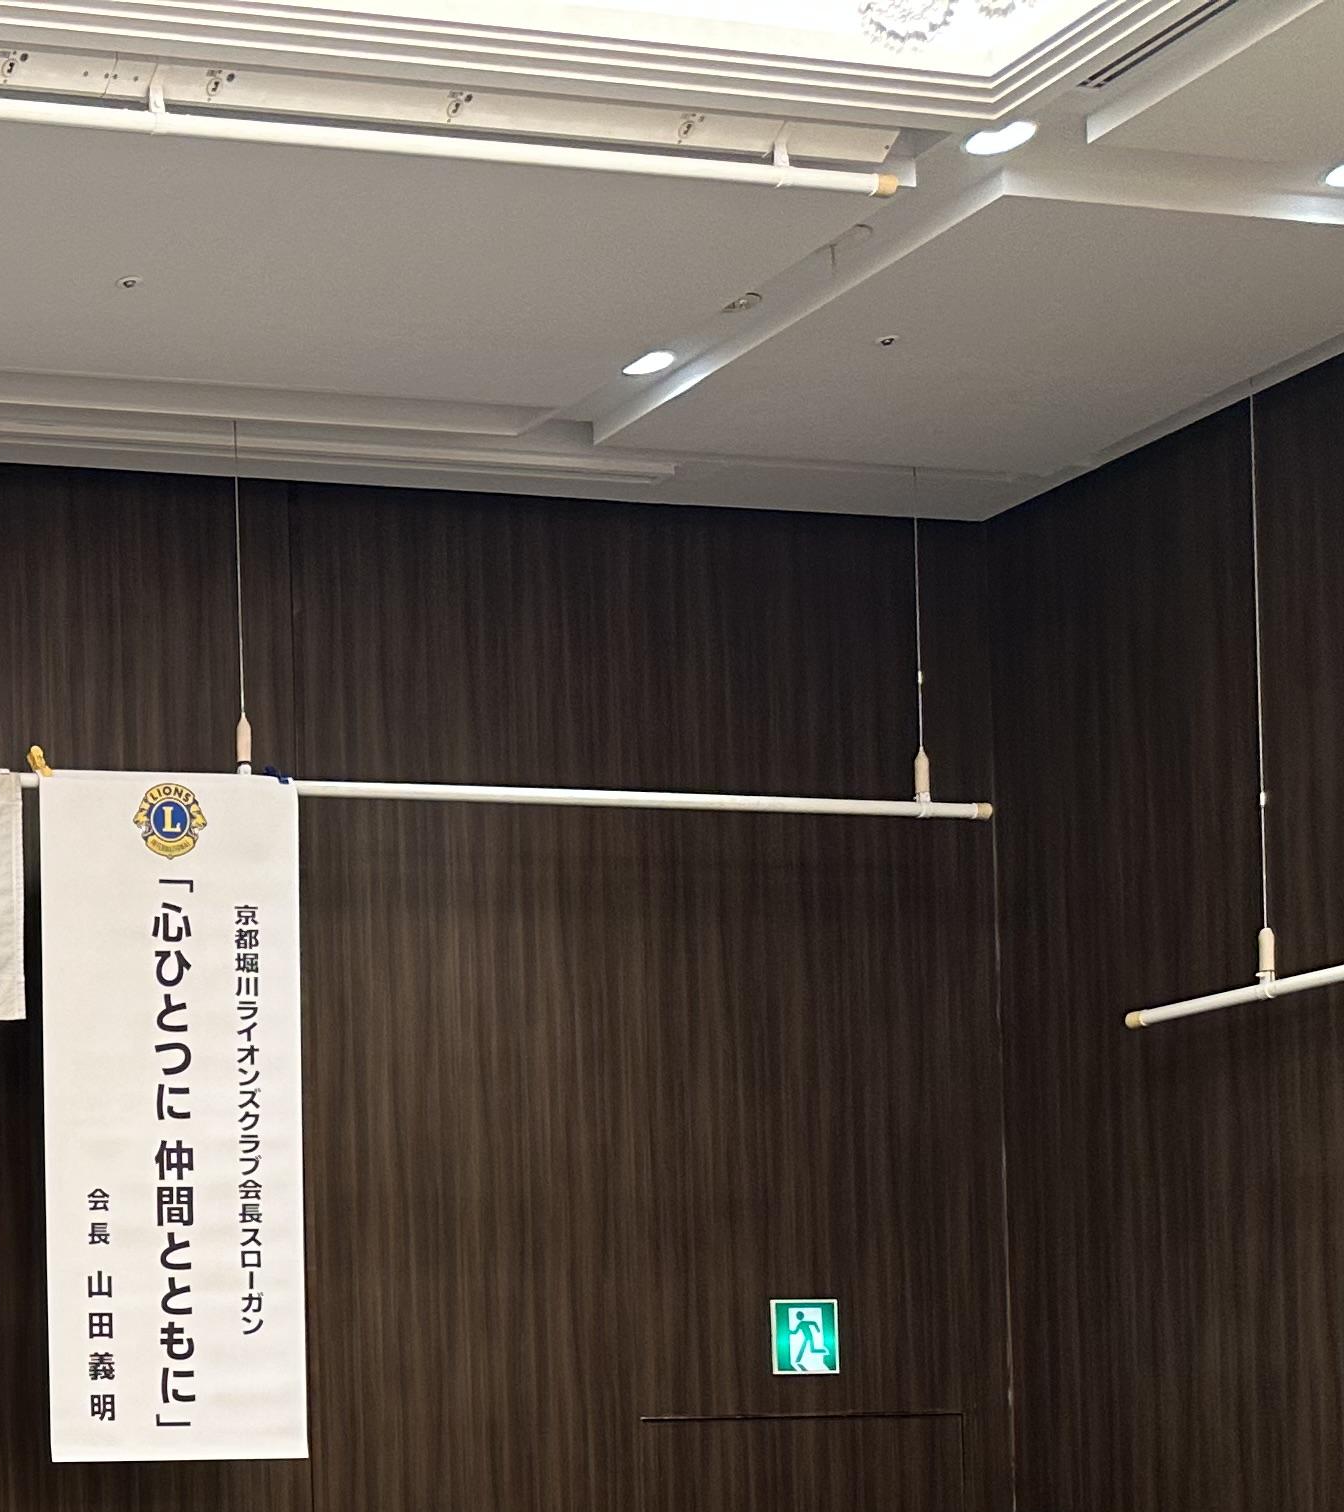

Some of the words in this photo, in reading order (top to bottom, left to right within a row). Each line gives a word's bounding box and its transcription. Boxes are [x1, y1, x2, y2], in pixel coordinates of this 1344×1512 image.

[149, 786, 192, 802] LIONS
[162, 806, 181, 832] L
[234, 904, 264, 1335] 京都堀川ライオンズクラブ会長スローガン
[87, 1188, 111, 1246] 会長
[87, 1270, 116, 1421] 山田義明
